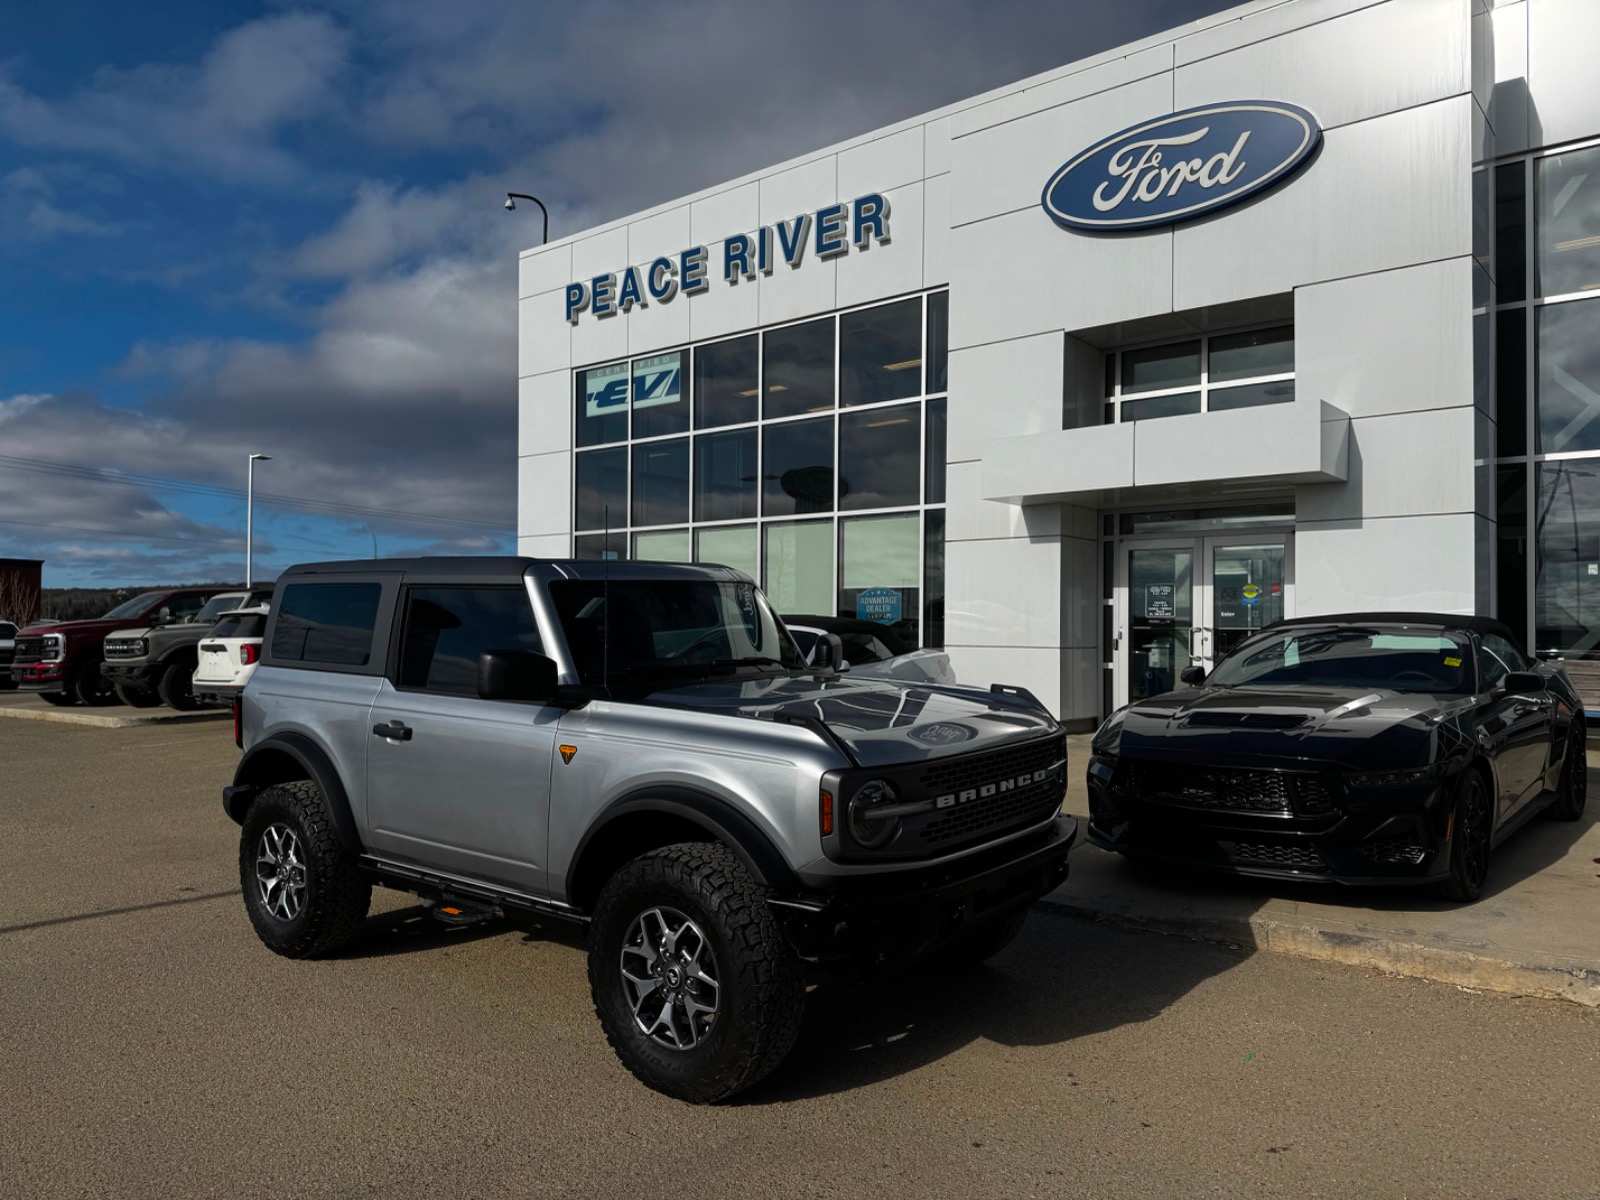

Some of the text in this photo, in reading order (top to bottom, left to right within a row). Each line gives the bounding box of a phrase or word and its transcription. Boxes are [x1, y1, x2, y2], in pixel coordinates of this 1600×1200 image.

[1092, 126, 1252, 211] Ford
[565, 192, 891, 324] PEACE RIVER
[936, 770, 1046, 809] BRONCO
